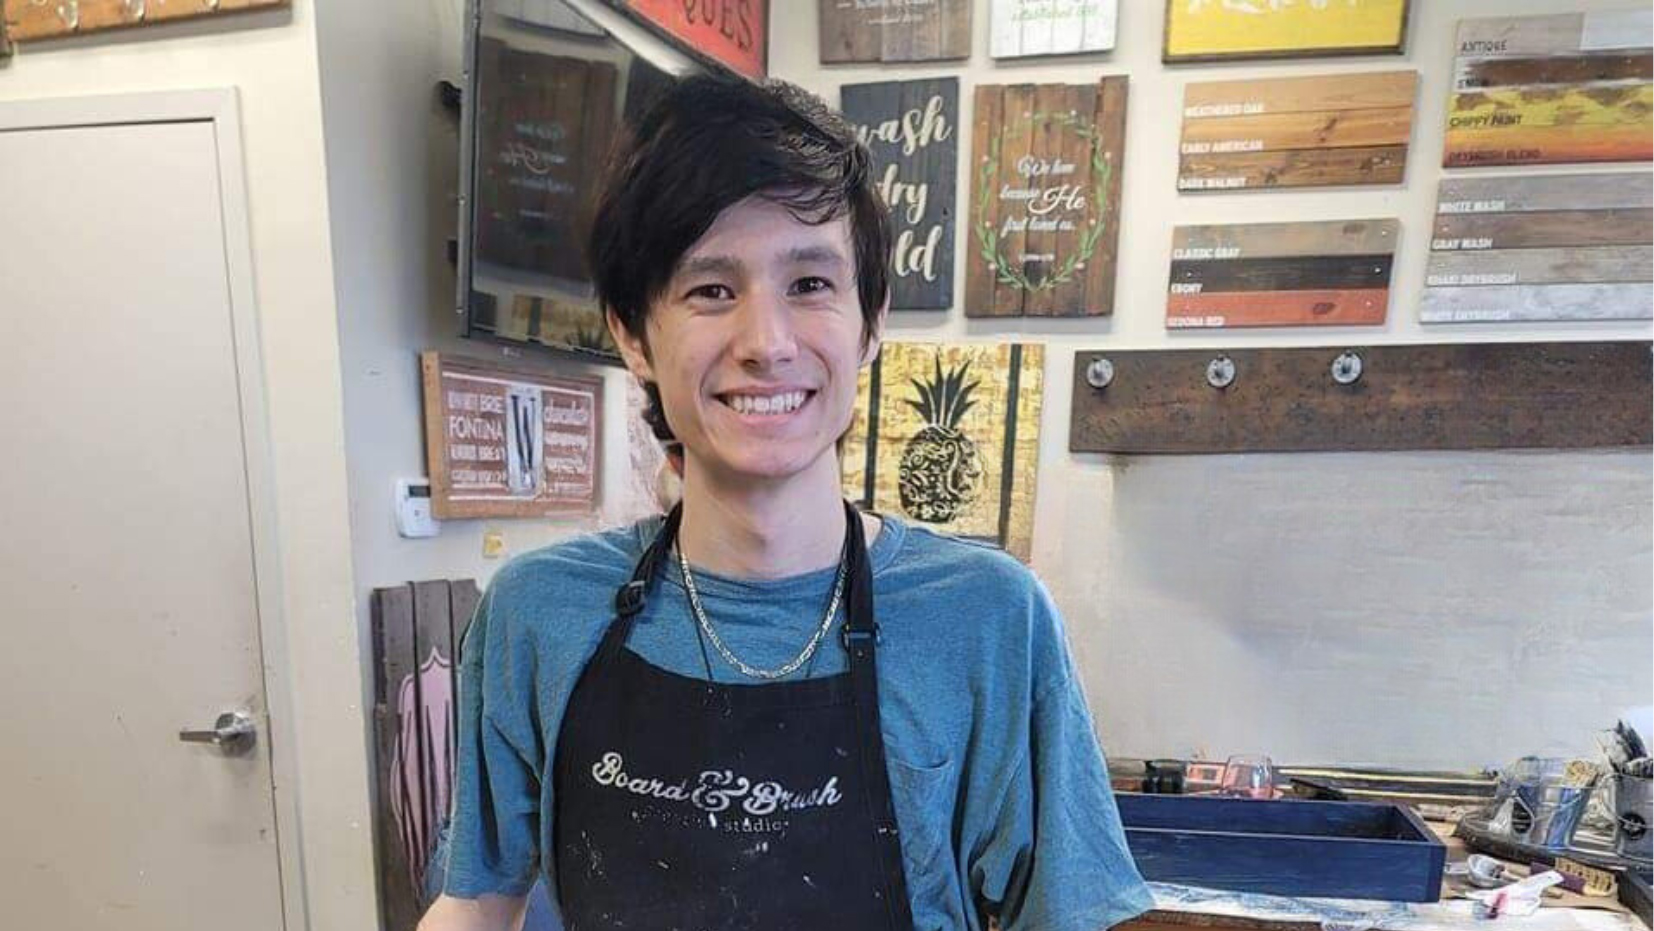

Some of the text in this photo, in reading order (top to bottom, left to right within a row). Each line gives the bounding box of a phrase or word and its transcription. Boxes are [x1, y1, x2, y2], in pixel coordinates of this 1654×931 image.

[1461, 40, 1507, 52] ANTIQUE
[1028, 183, 1086, 214] He
[1460, 237, 1493, 249] WASH
[1171, 283, 1203, 294] EBONY
[449, 415, 506, 441] FONTINA
[592, 752, 690, 801] Board
[742, 776, 842, 815] Brush
